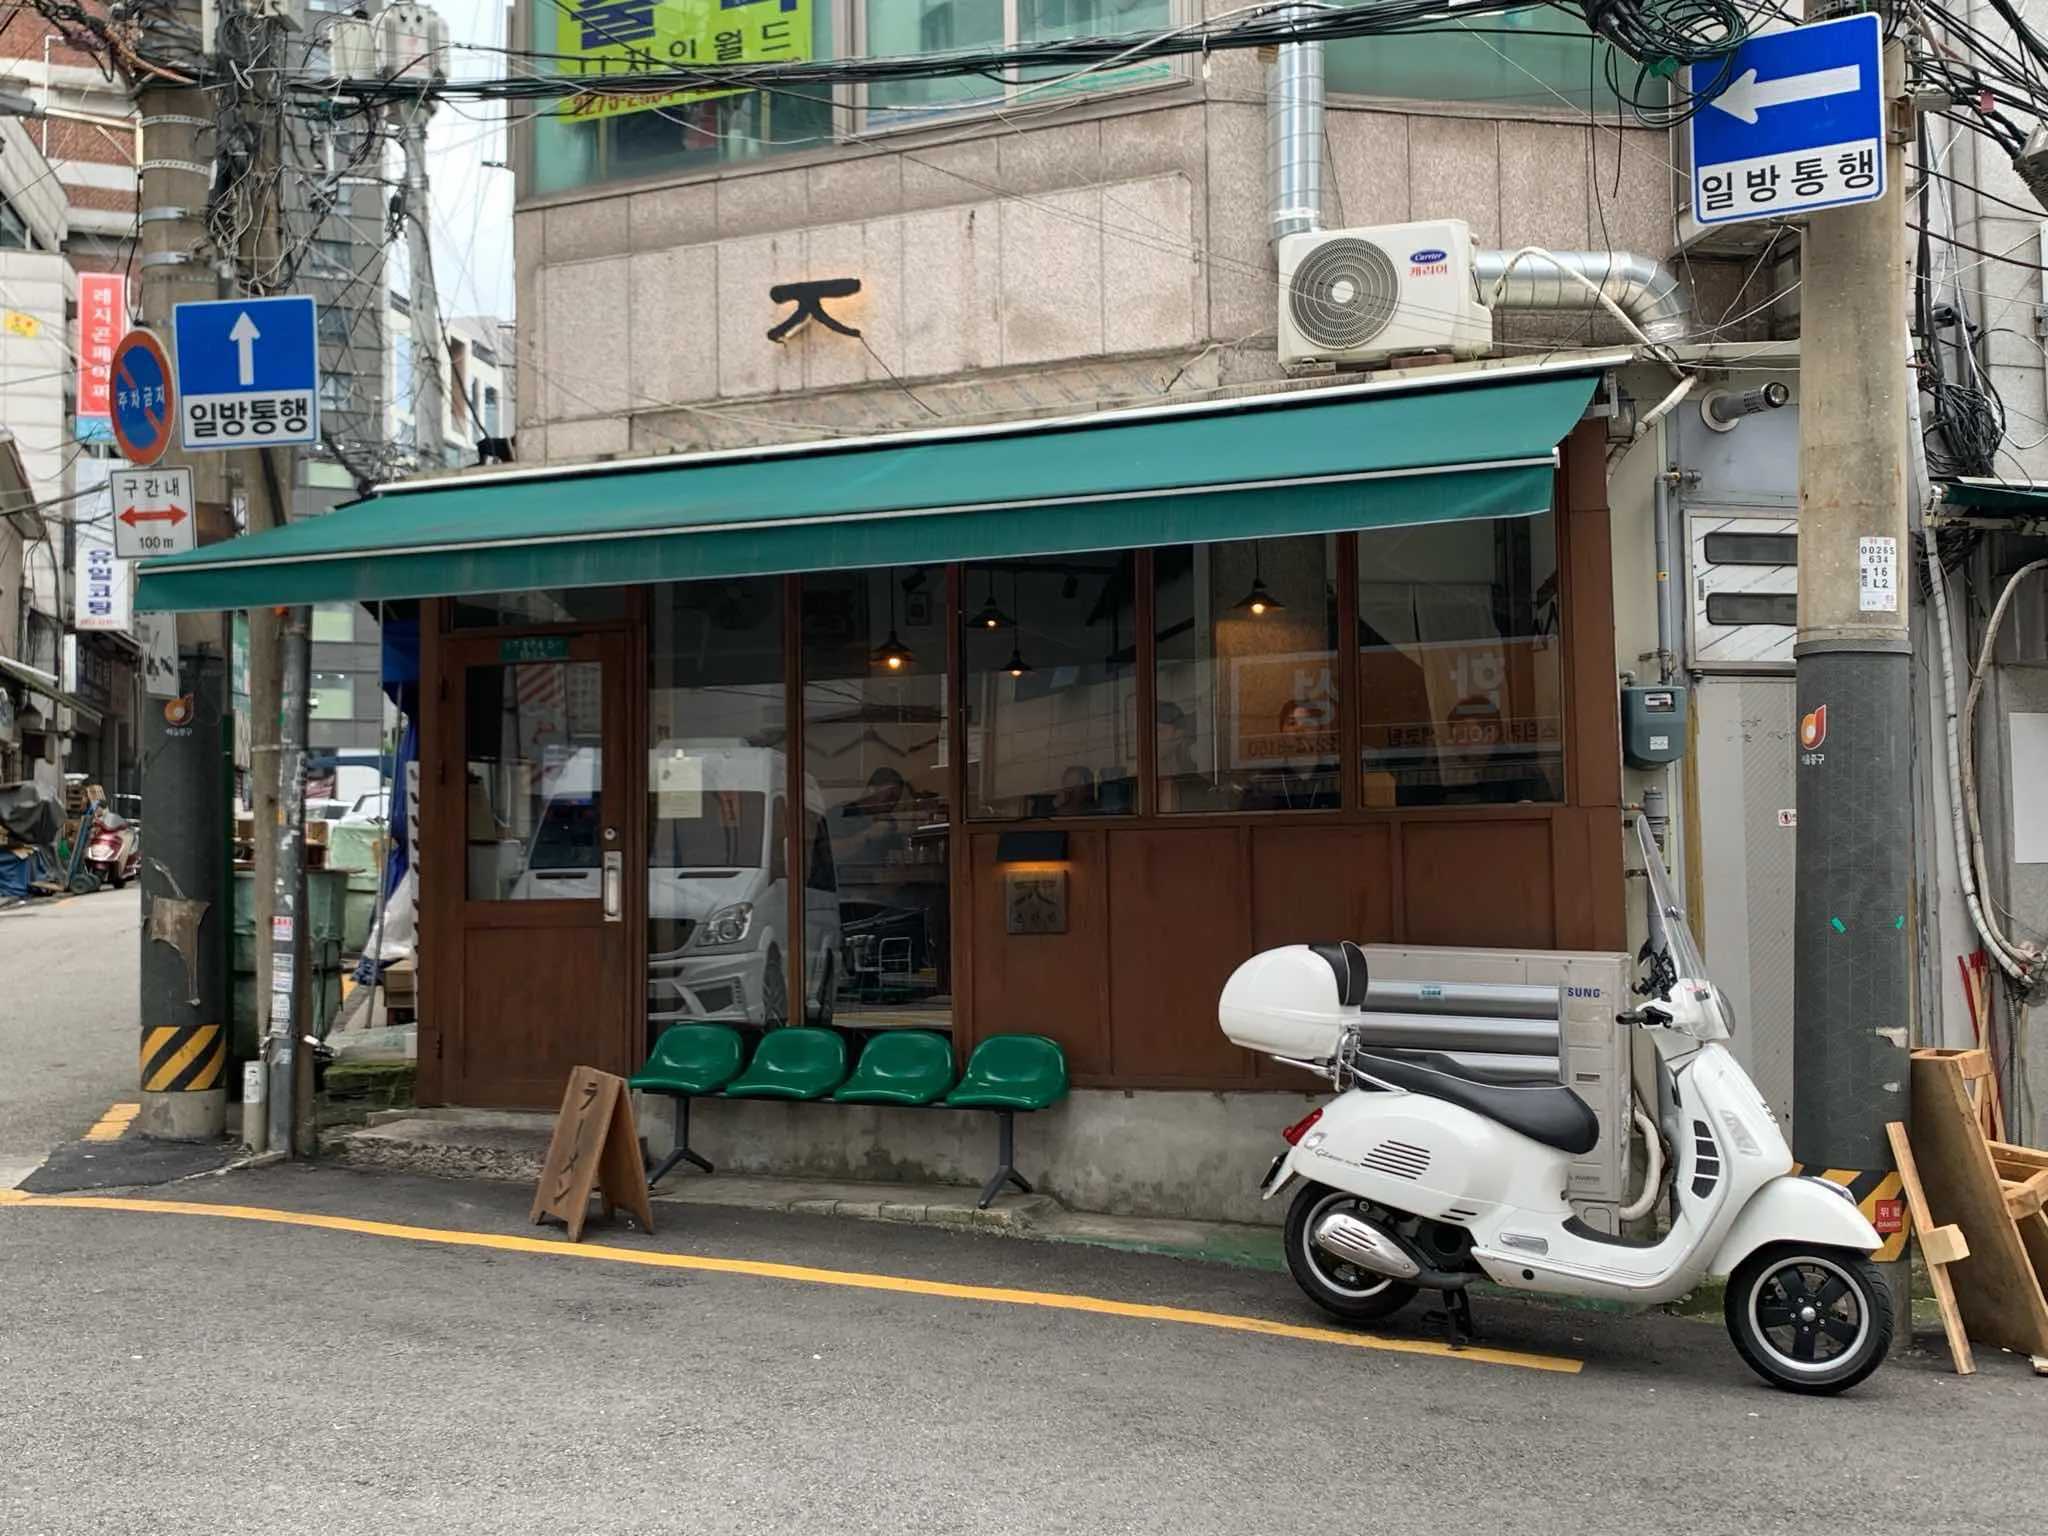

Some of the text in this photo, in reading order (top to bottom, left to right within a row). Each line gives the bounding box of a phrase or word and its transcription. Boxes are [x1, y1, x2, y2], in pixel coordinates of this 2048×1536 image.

[1701, 148, 1875, 211] 일방통행
[1413, 251, 1444, 262] Carrier
[1408, 264, 1448, 277] 캐리어
[117, 384, 165, 411] 주차금지
[189, 397, 308, 438] 일방통행
[1873, 566, 1888, 577] 16
[1873, 578, 1889, 589] L2
[552, 1081, 599, 1206] ラーメン
